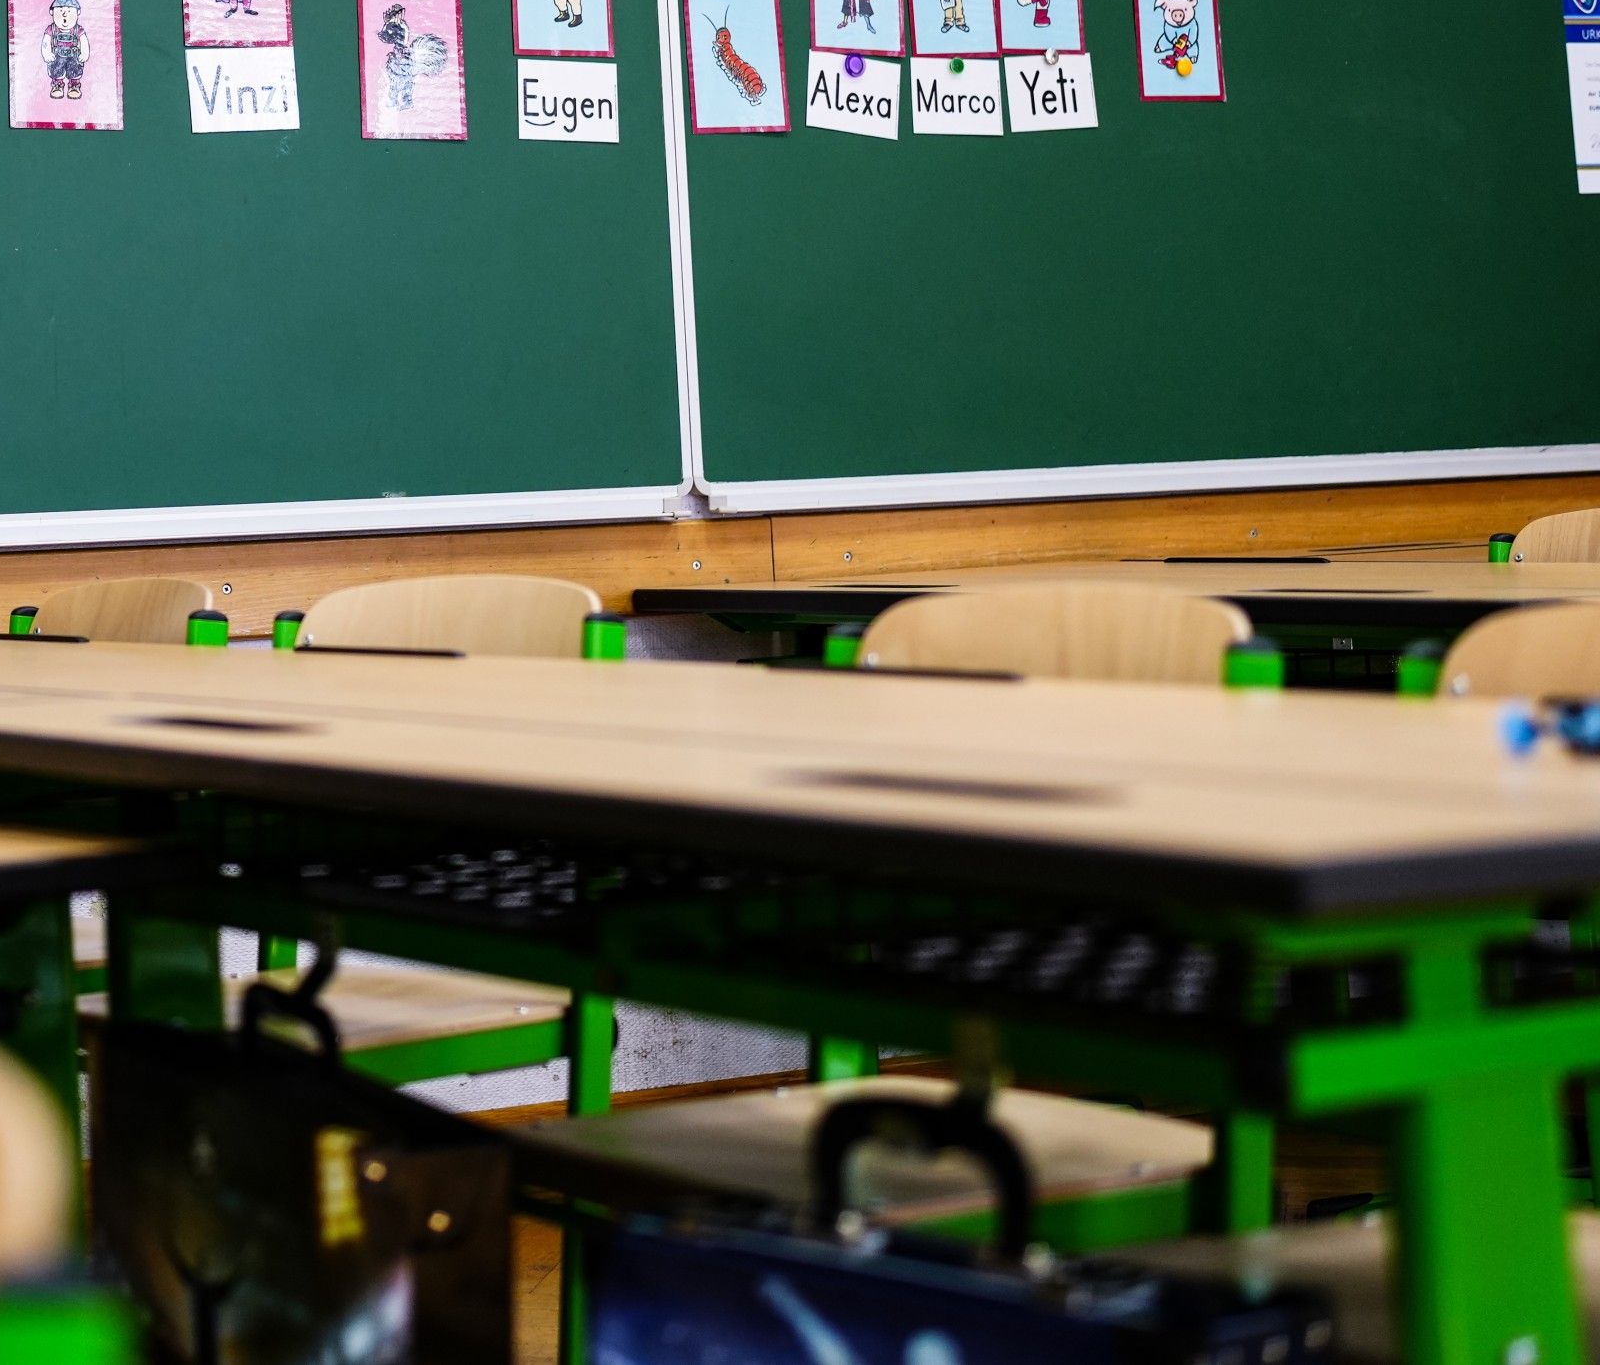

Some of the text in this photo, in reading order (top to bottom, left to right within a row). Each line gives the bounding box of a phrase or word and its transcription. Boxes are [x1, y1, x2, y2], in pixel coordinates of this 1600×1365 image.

[192, 65, 288, 115] Vinzi
[523, 79, 613, 133] Eugen
[810, 71, 892, 119] Alexa
[917, 80, 997, 115] Marco
[1020, 68, 1079, 115] Yeti
